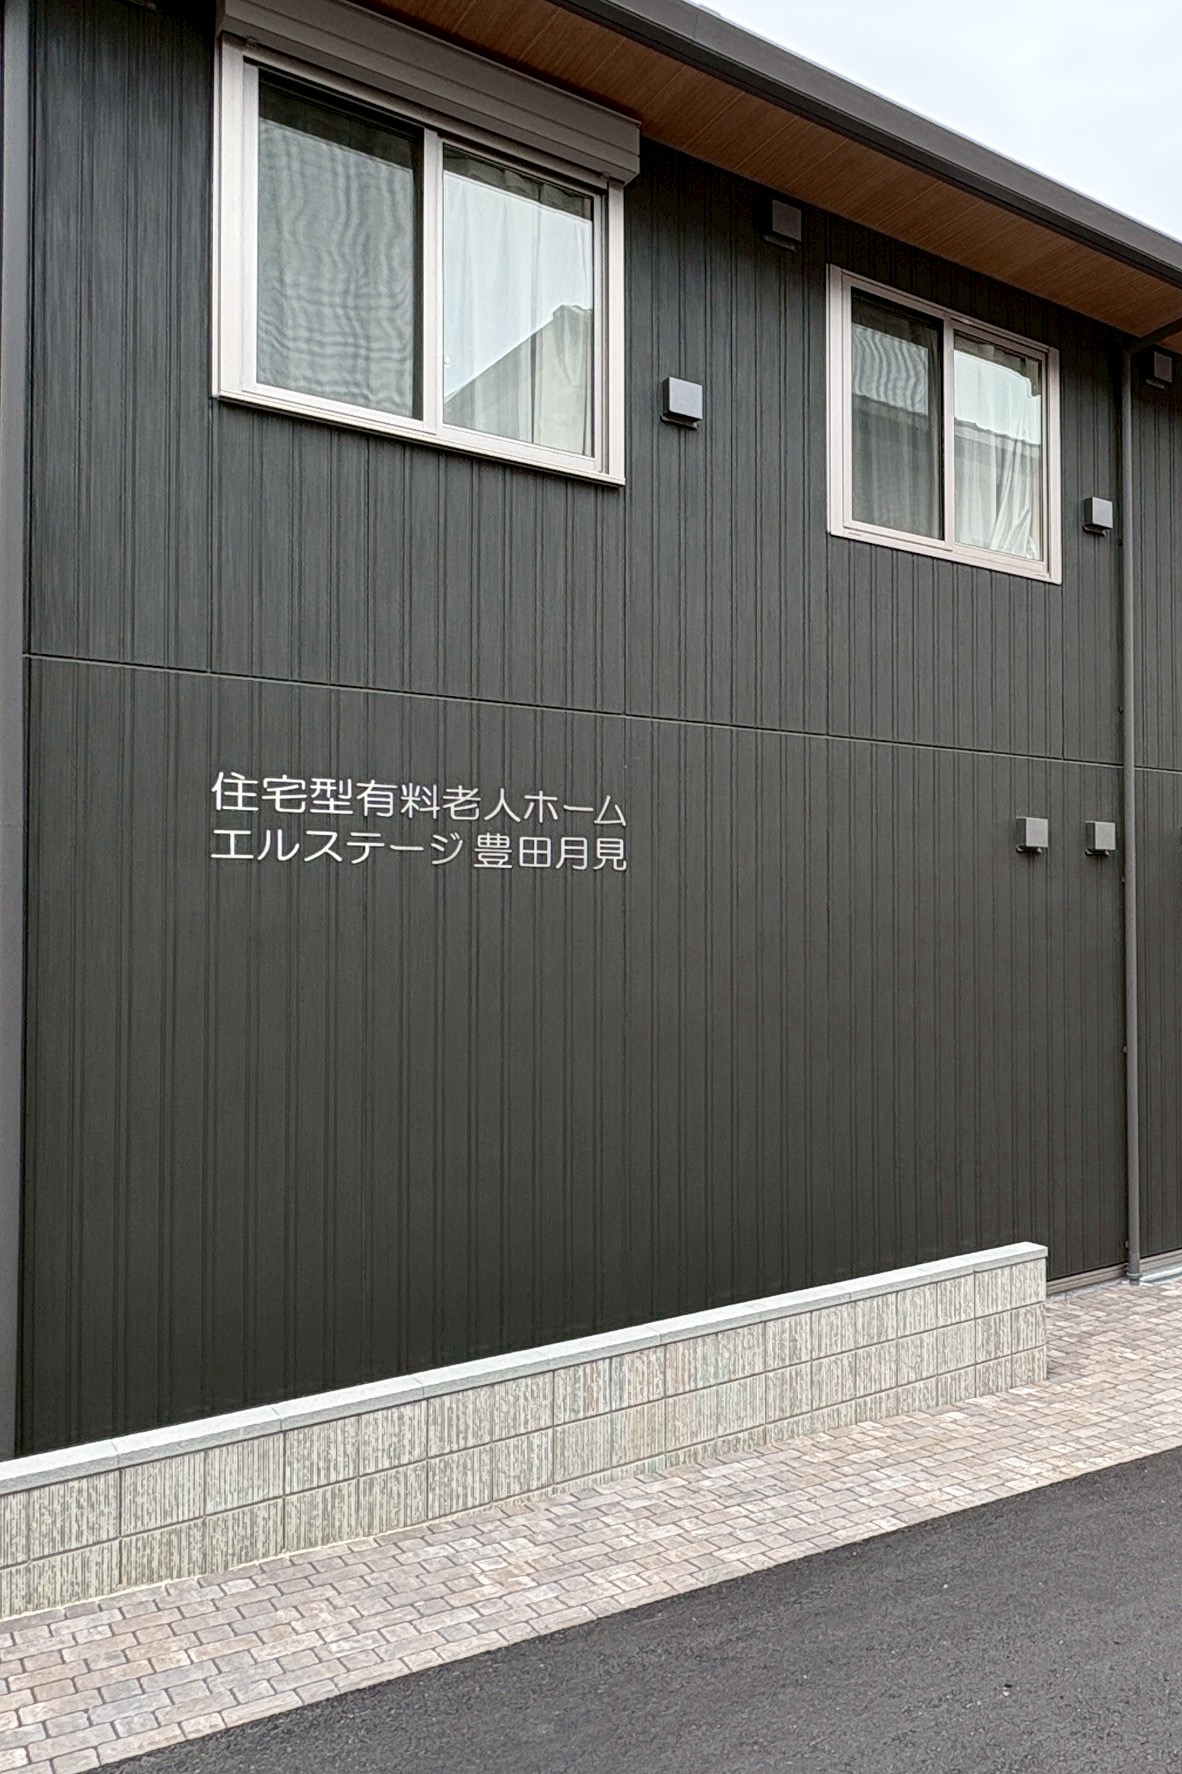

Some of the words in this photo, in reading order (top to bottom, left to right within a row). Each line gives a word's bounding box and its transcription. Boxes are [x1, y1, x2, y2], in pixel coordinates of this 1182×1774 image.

[211, 771, 628, 828] 住宅型有料老人ホーム
[210, 828, 628, 871] エルステージ豊田月見
